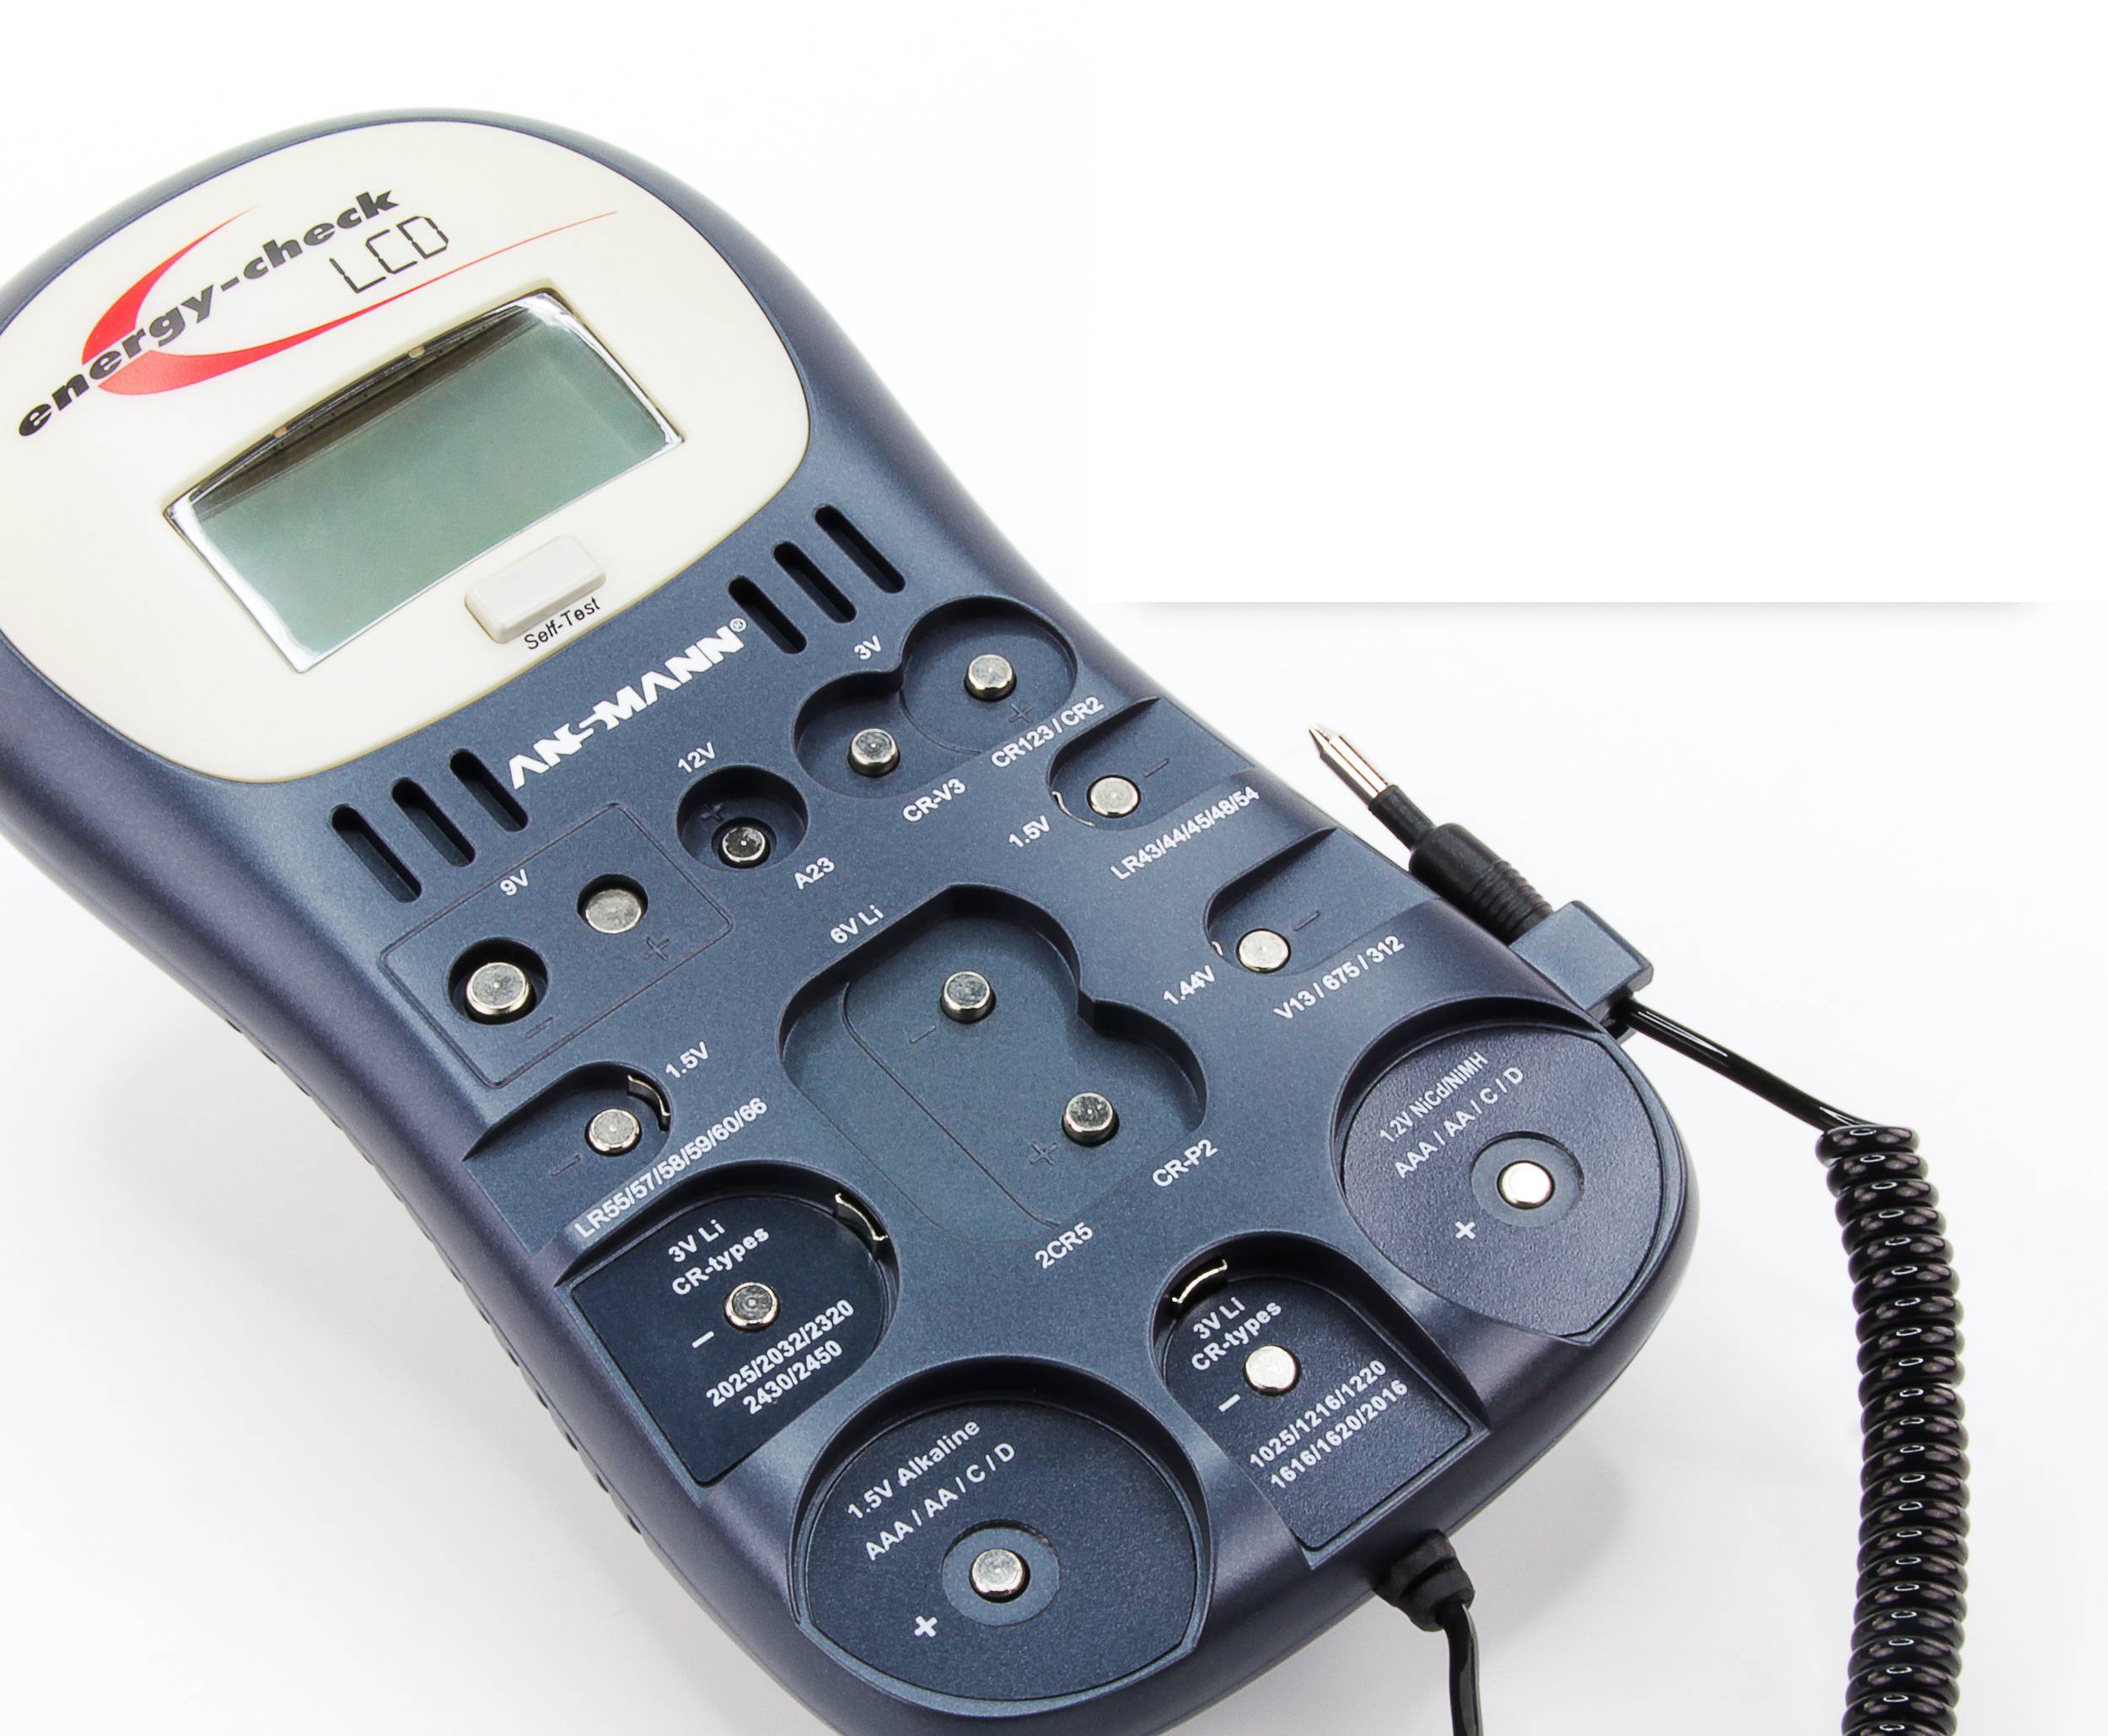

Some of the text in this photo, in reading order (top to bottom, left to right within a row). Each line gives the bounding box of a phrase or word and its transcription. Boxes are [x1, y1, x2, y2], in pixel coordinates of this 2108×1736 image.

[329, 216, 449, 293] LCD
[18, 190, 401, 438] energy-check
[524, 597, 601, 651] Self-Test
[853, 635, 882, 660] 3V
[678, 742, 716, 773] 12V
[991, 724, 1054, 768] CR123
[1061, 696, 1105, 727] CR2
[902, 778, 966, 822] CR-V3
[1008, 815, 1051, 848] 1.5V
[1110, 786, 1260, 880] LR43/44/45/48/54
[500, 868, 530, 896] 9V
[793, 857, 835, 889] A23
[830, 905, 885, 943] 6V Li
[1163, 965, 1216, 1006] 1.44V
[1273, 990, 1317, 1020] V13
[1322, 960, 1360, 992] 675
[1366, 935, 1405, 963] 312
[665, 1041, 709, 1079] 1.5V
[1379, 1051, 1488, 1142] 1.2V NiCd/NiMH
[1394, 1141, 1438, 1180] AAA
[1443, 1110, 1476, 1137] AA
[1480, 1088, 1498, 1104] C
[1503, 1067, 1524, 1085] D
[574, 1097, 769, 1239] LR55/57/58/59/60/66
[1152, 1139, 1218, 1188] CR-P2
[668, 1219, 725, 1263] 3V Li
[671, 1226, 769, 1296] CR-types
[1035, 1222, 1094, 1269] 2CR5
[705, 1299, 854, 1408] 2025/2032/2320
[1191, 1299, 1283, 1373] CR-types
[1193, 1297, 1246, 1341] 3V Li
[742, 1339, 843, 1415] 2430/2450
[1249, 1359, 1388, 1470] 1025/1216/1220
[1270, 1379, 1408, 1490] 1616/1620/2016
[847, 1419, 981, 1520] 1.5V Alkaline
[864, 1519, 914, 1561] AAA
[923, 1488, 956, 1520] AA
[965, 1464, 987, 1484] C
[995, 1441, 1015, 1463] D
